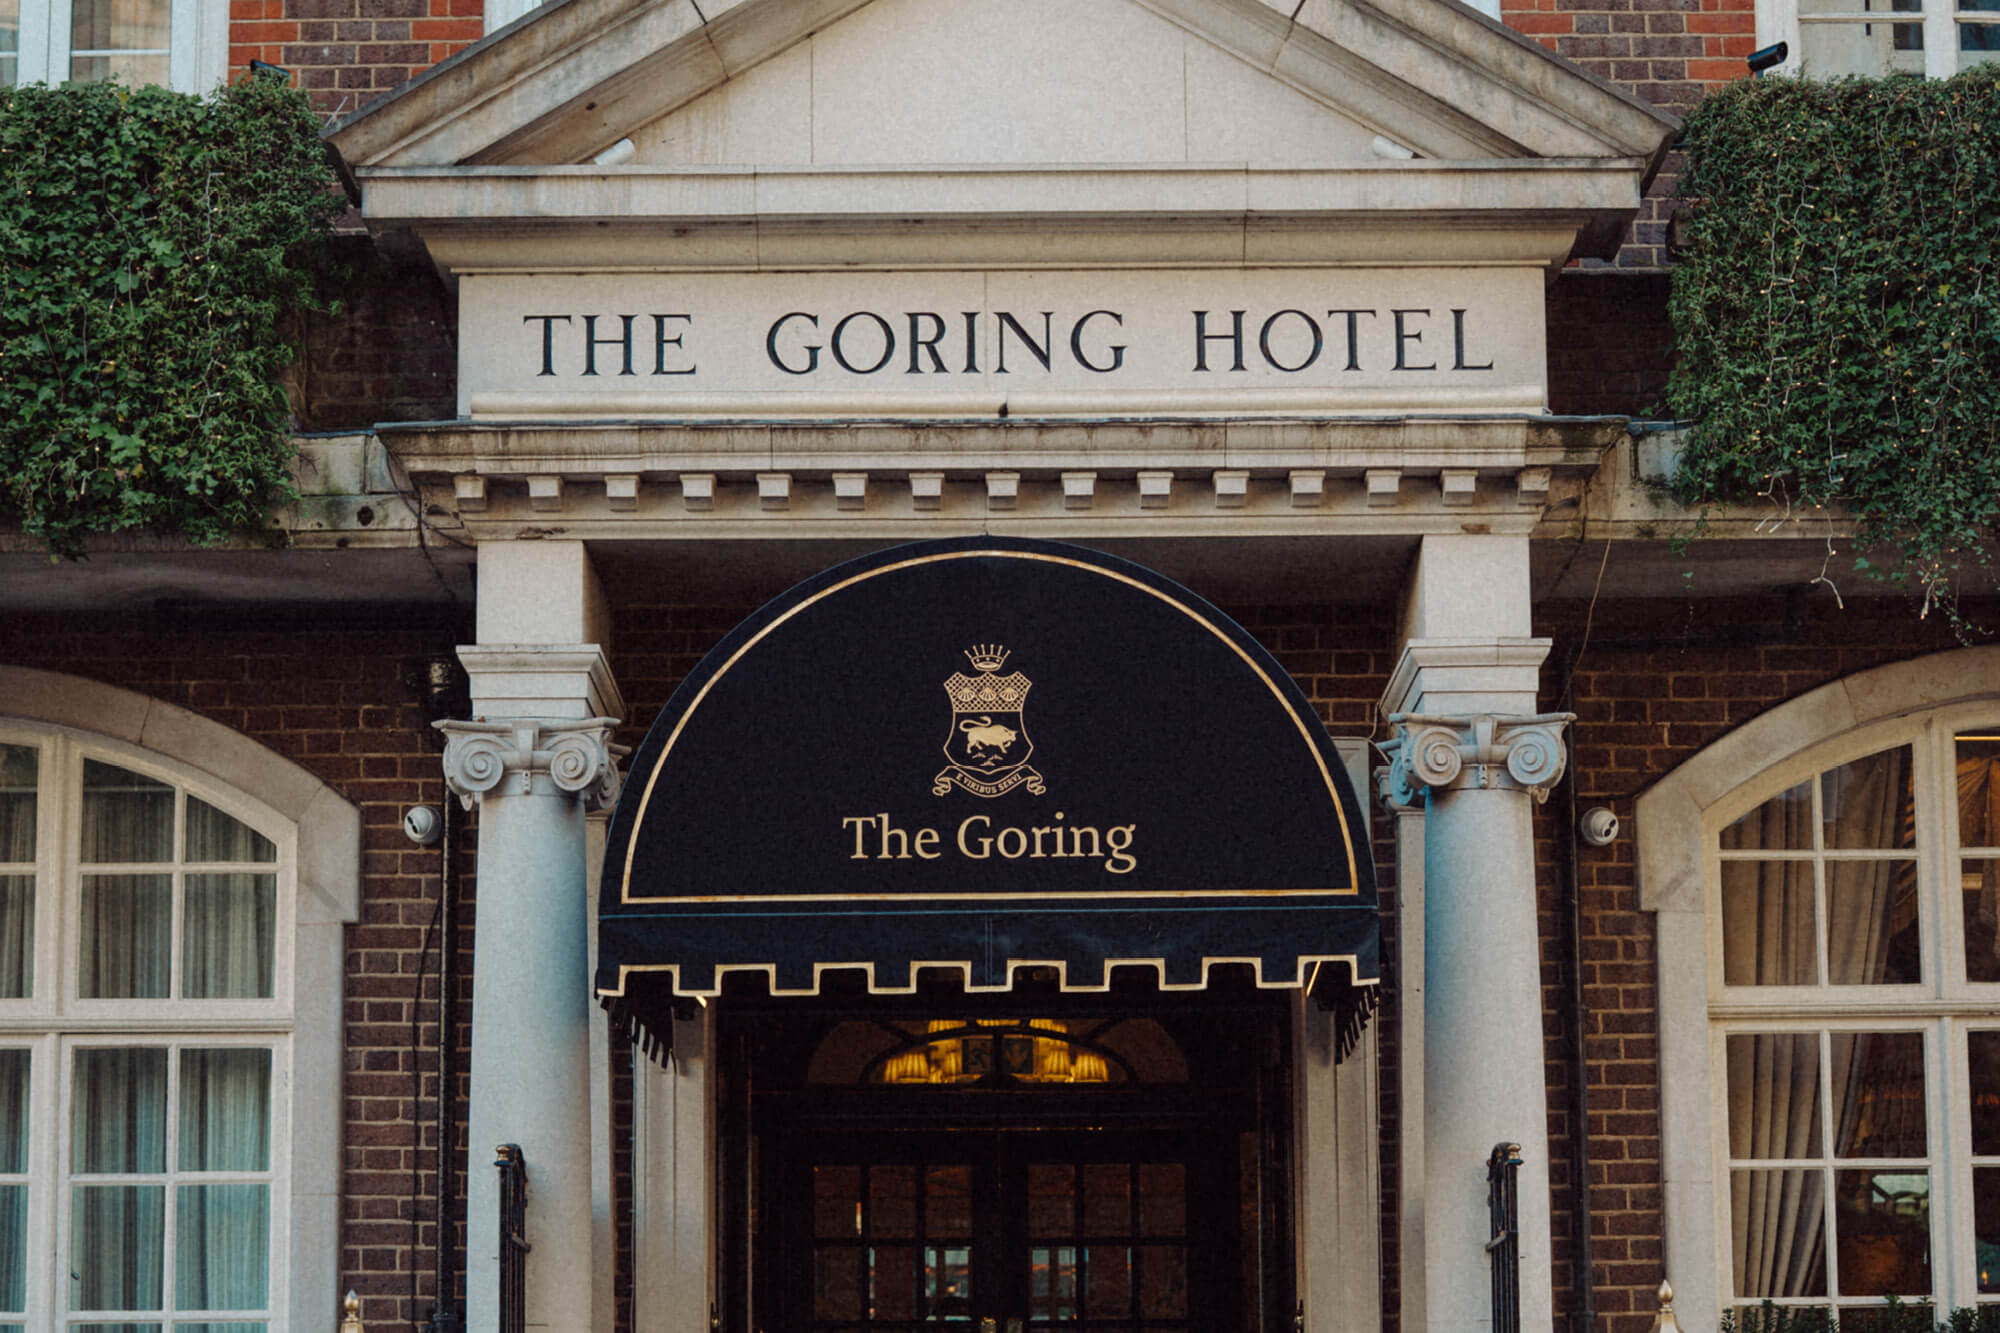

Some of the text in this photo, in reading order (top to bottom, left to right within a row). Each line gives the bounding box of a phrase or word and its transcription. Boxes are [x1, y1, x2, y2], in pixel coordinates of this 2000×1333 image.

[524, 308, 1494, 377] THE GORING HOTEL
[842, 811, 1137, 874] The Goring
